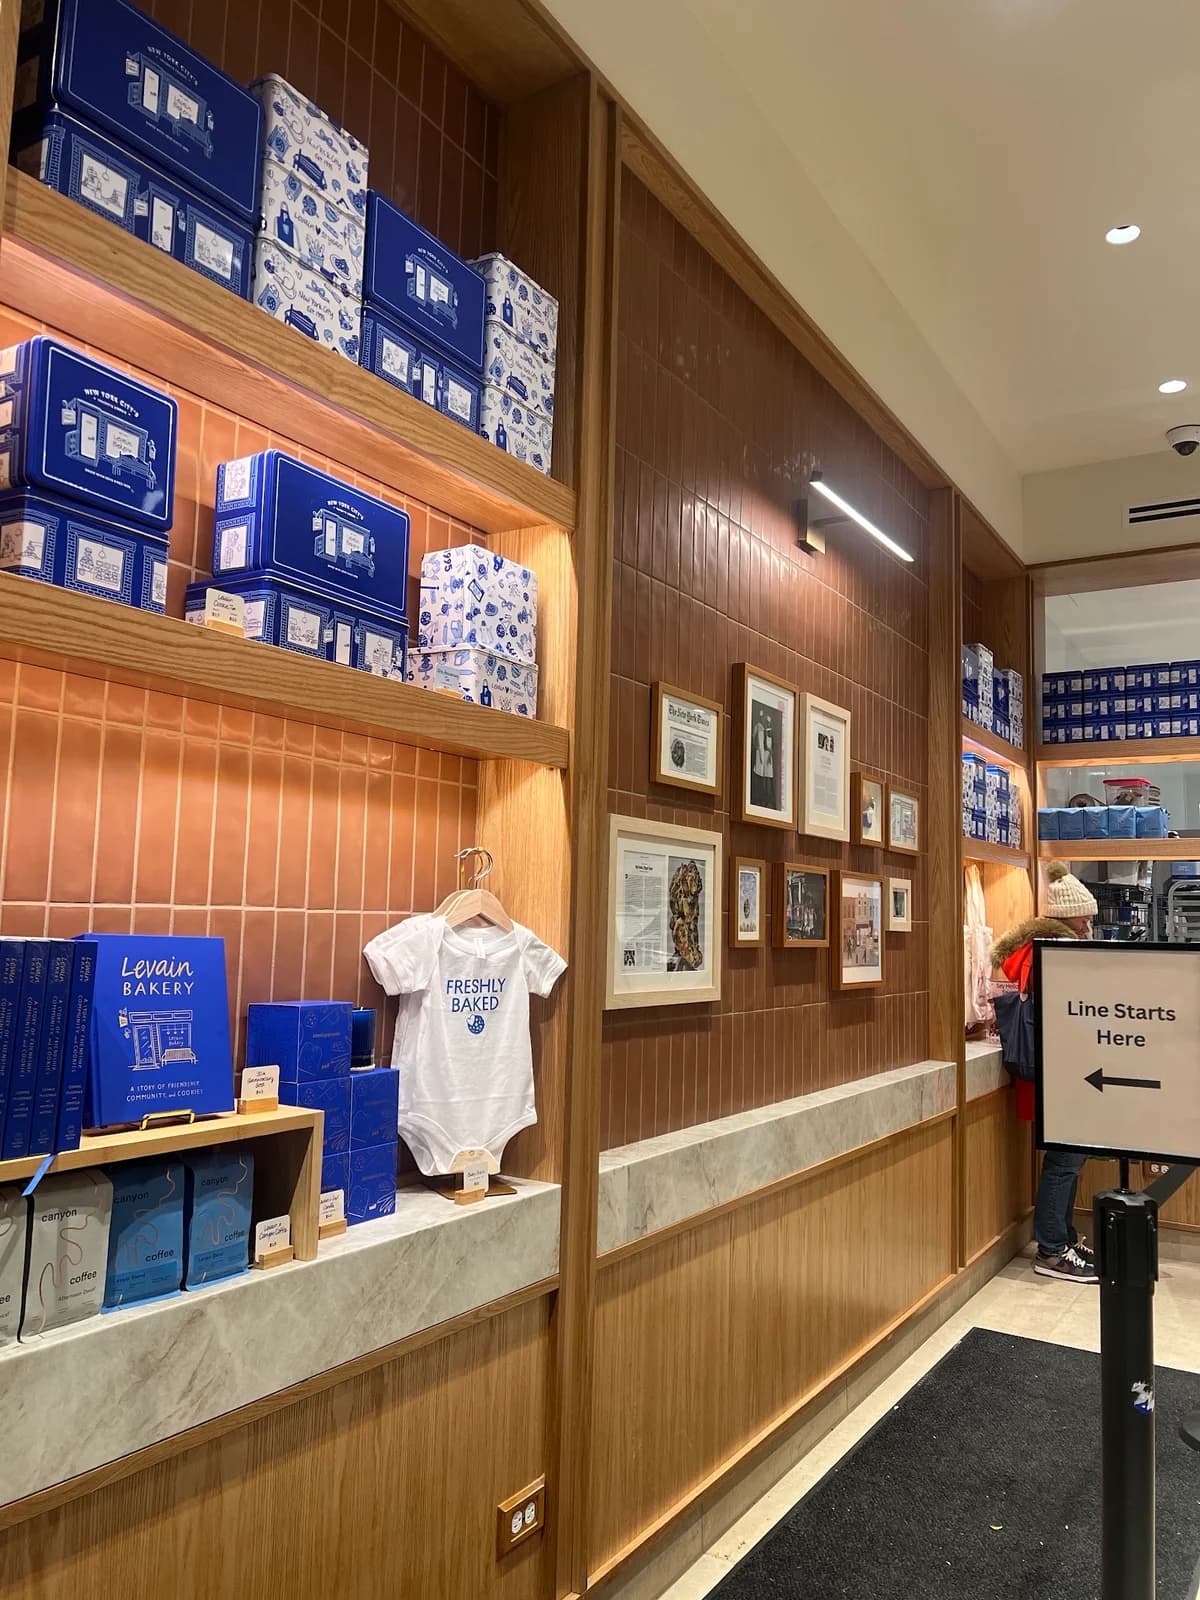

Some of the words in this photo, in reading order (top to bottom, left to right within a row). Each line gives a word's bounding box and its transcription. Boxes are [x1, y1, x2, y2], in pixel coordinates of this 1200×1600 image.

[121, 956, 194, 979] Levain
[123, 981, 194, 996] BAKERY
[446, 977, 506, 995] FRESHLY
[451, 996, 499, 1013] BAKED
[1067, 1000, 1109, 1018] Line
[1114, 1003, 1176, 1021] Starts
[1097, 1029, 1146, 1047] Here
[137, 1084, 155, 1092] STORY
[200, 1175, 229, 1187] canyon
[113, 1190, 149, 1204] canyon
[41, 1208, 77, 1223] canyon
[224, 1229, 245, 1242] coffee
[145, 1249, 175, 1262] coffee
[69, 1270, 97, 1285] coffee
